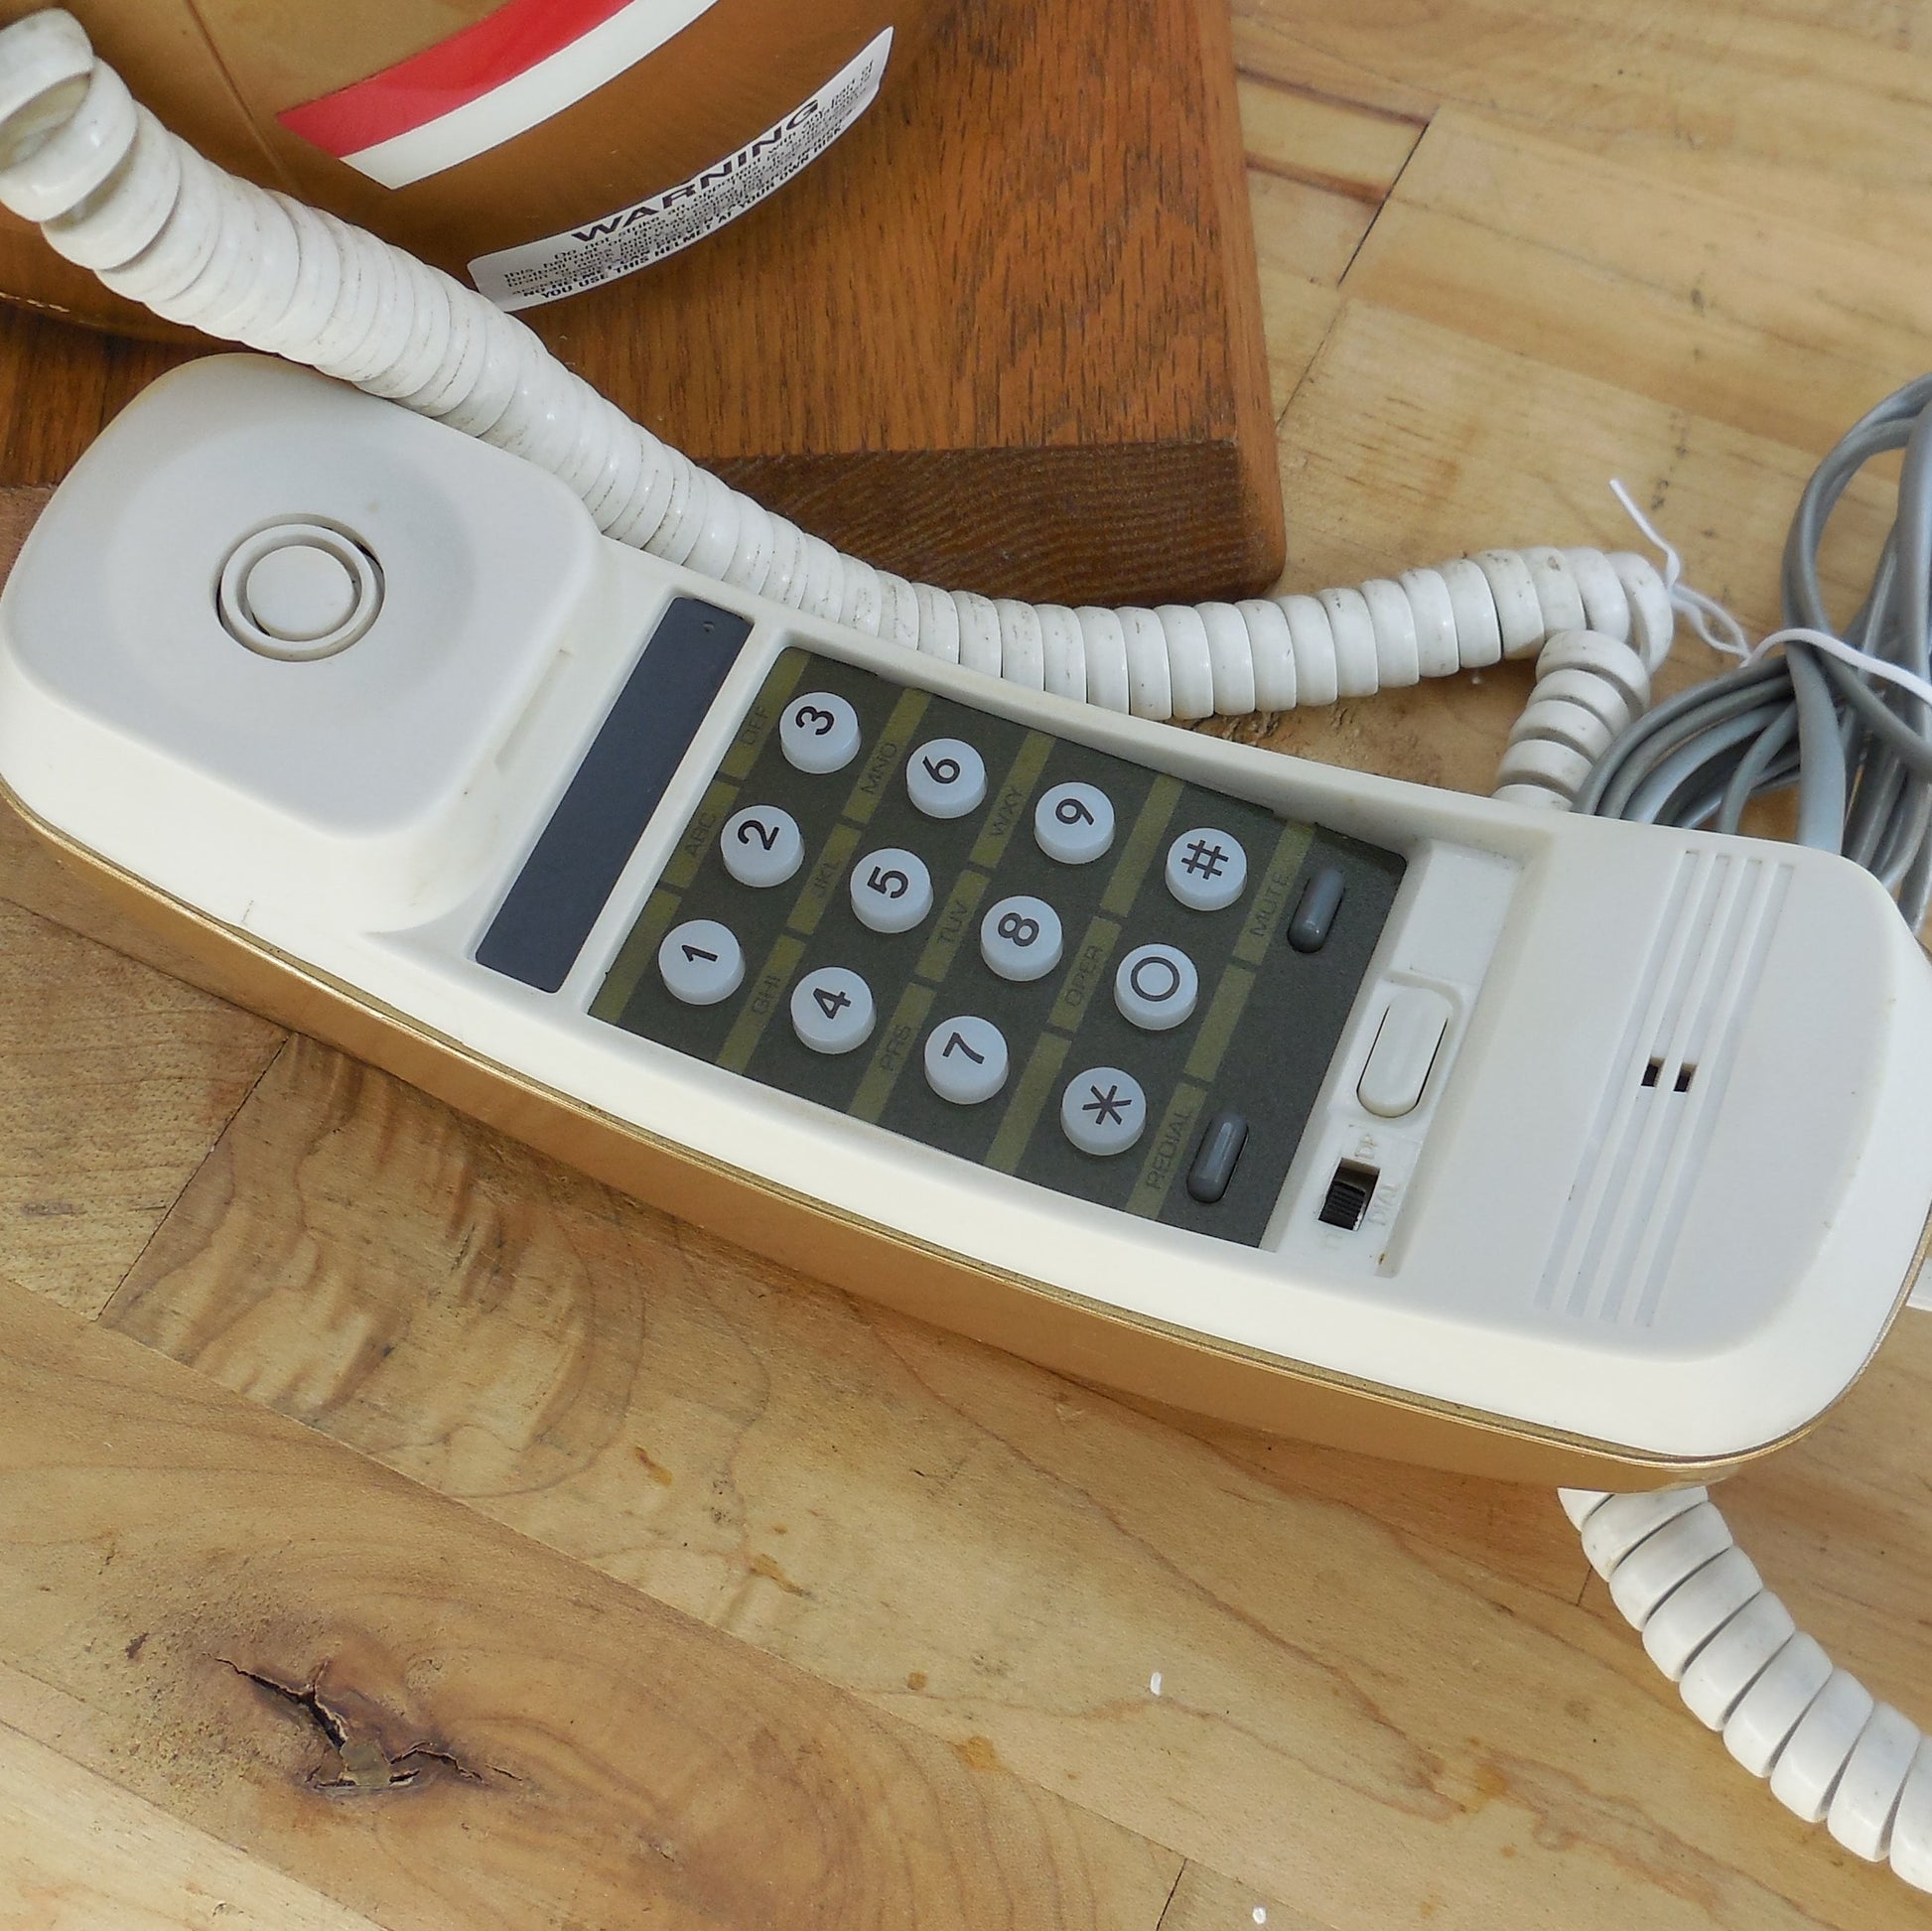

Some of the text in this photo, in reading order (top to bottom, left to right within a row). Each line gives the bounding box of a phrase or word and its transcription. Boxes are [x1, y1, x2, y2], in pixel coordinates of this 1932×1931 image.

[570, 96, 818, 244] WARNING
[540, 123, 841, 299] YOU USE THIS HELMET AT YOUR OWN RISK
[795, 705, 835, 736] 3
[922, 755, 961, 784] 6
[1054, 797, 1094, 826] 9
[737, 819, 779, 851] 2
[867, 865, 909, 900] 5
[1251, 874, 1290, 937] MUTE
[997, 911, 1039, 947] 8
[681, 943, 719, 964] 1
[1064, 945, 1103, 1007] OPER
[812, 987, 852, 1020] 4
[942, 1032, 985, 1065] 7
[1146, 1112, 1191, 1190] REDIAL
